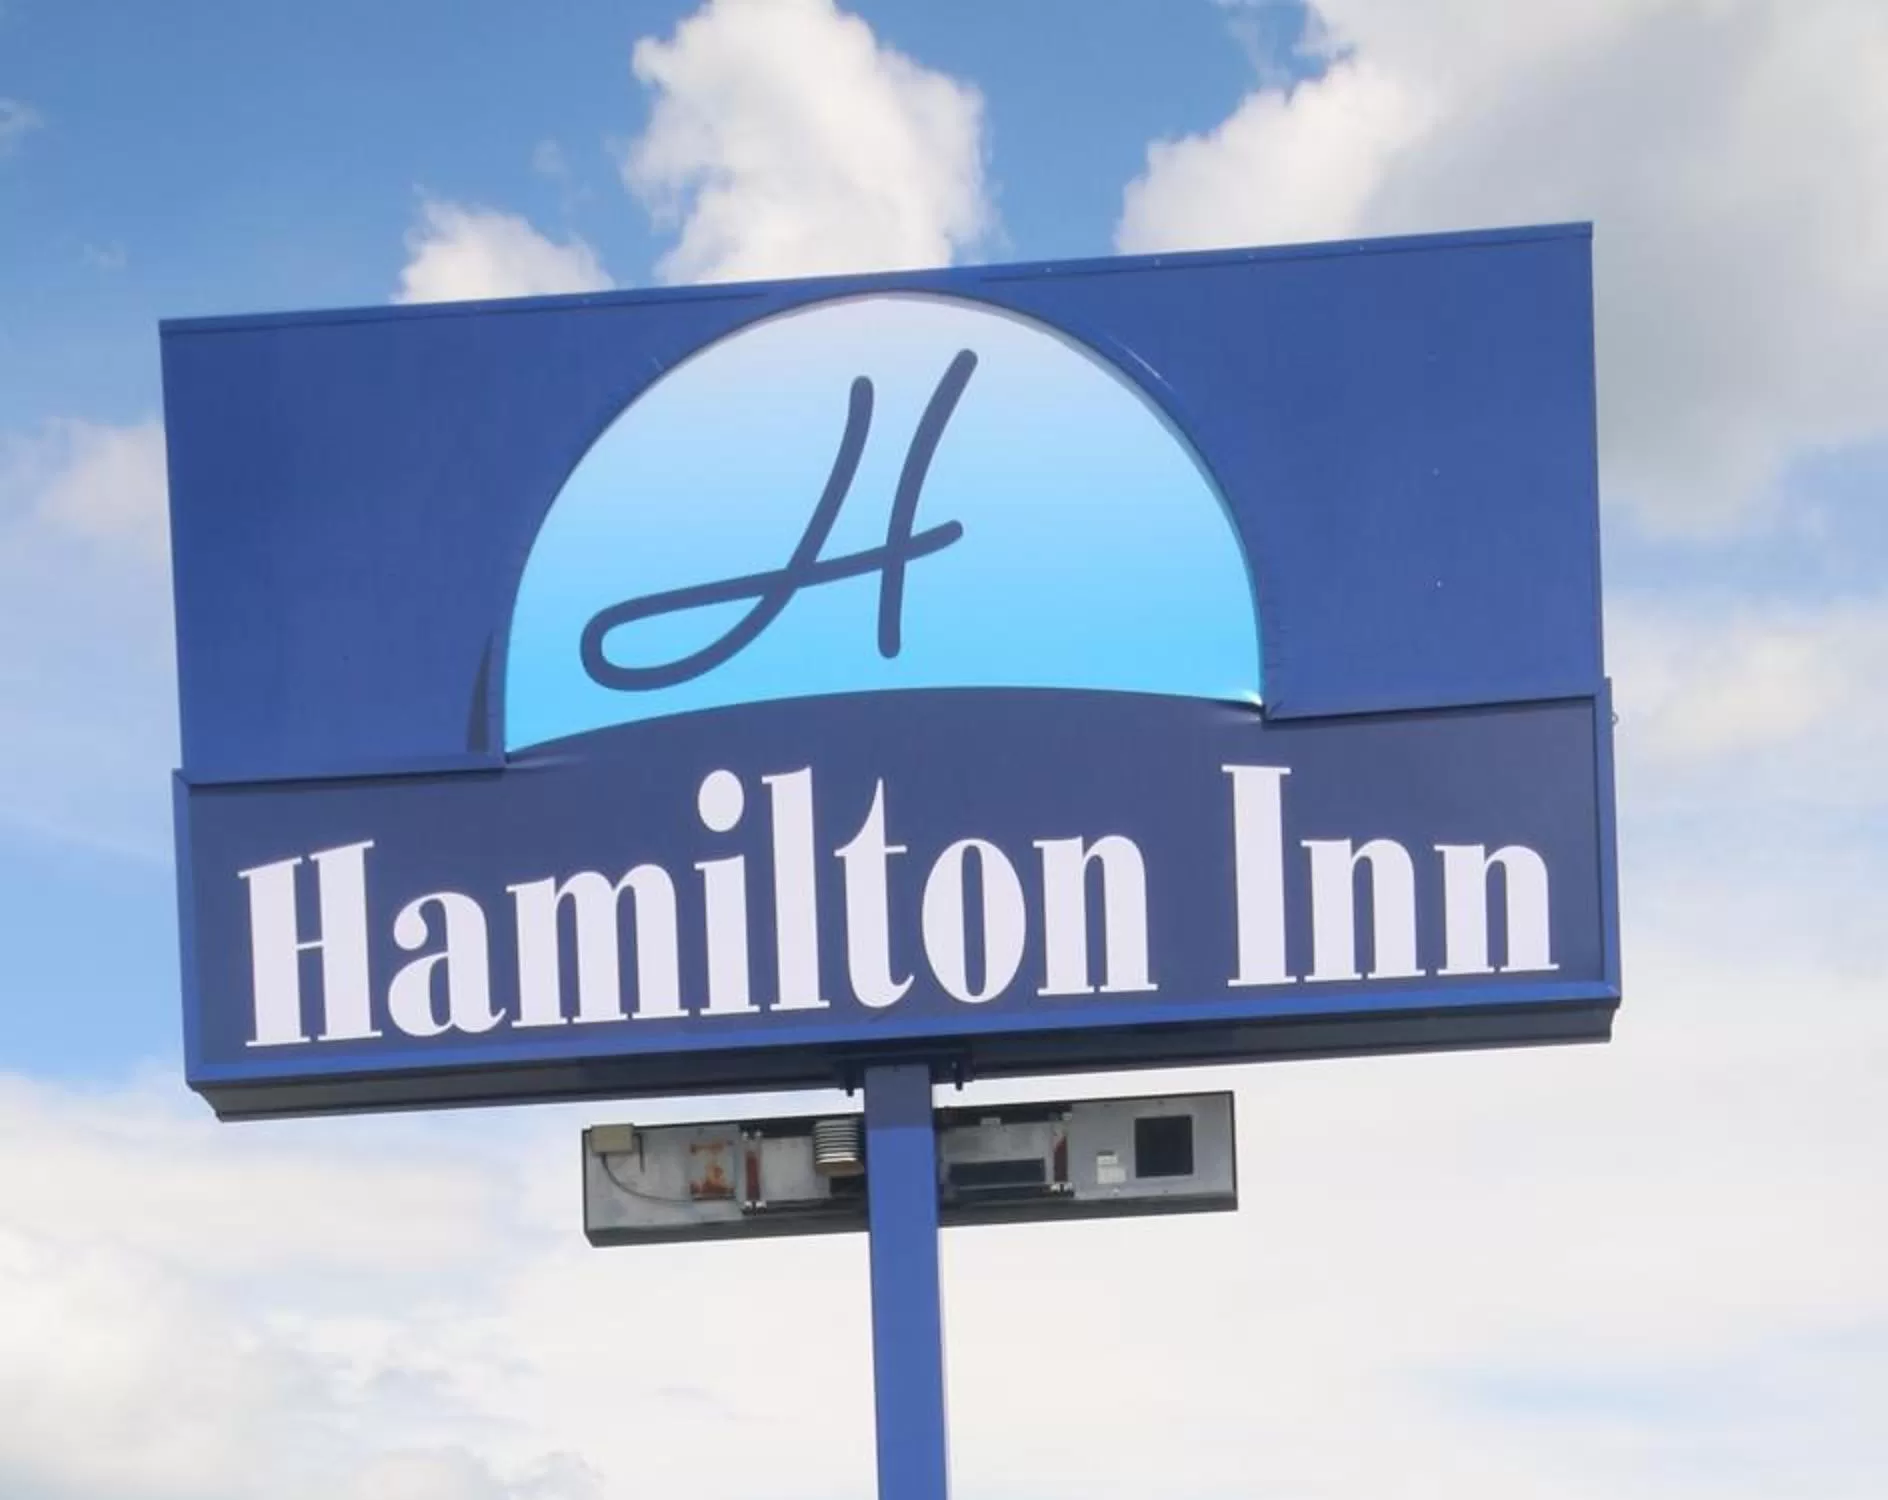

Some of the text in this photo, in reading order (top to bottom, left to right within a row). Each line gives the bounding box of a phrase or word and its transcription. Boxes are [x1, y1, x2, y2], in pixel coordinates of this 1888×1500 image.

[581, 350, 977, 691] H
[239, 765, 1559, 1046] Hamilton Inn
